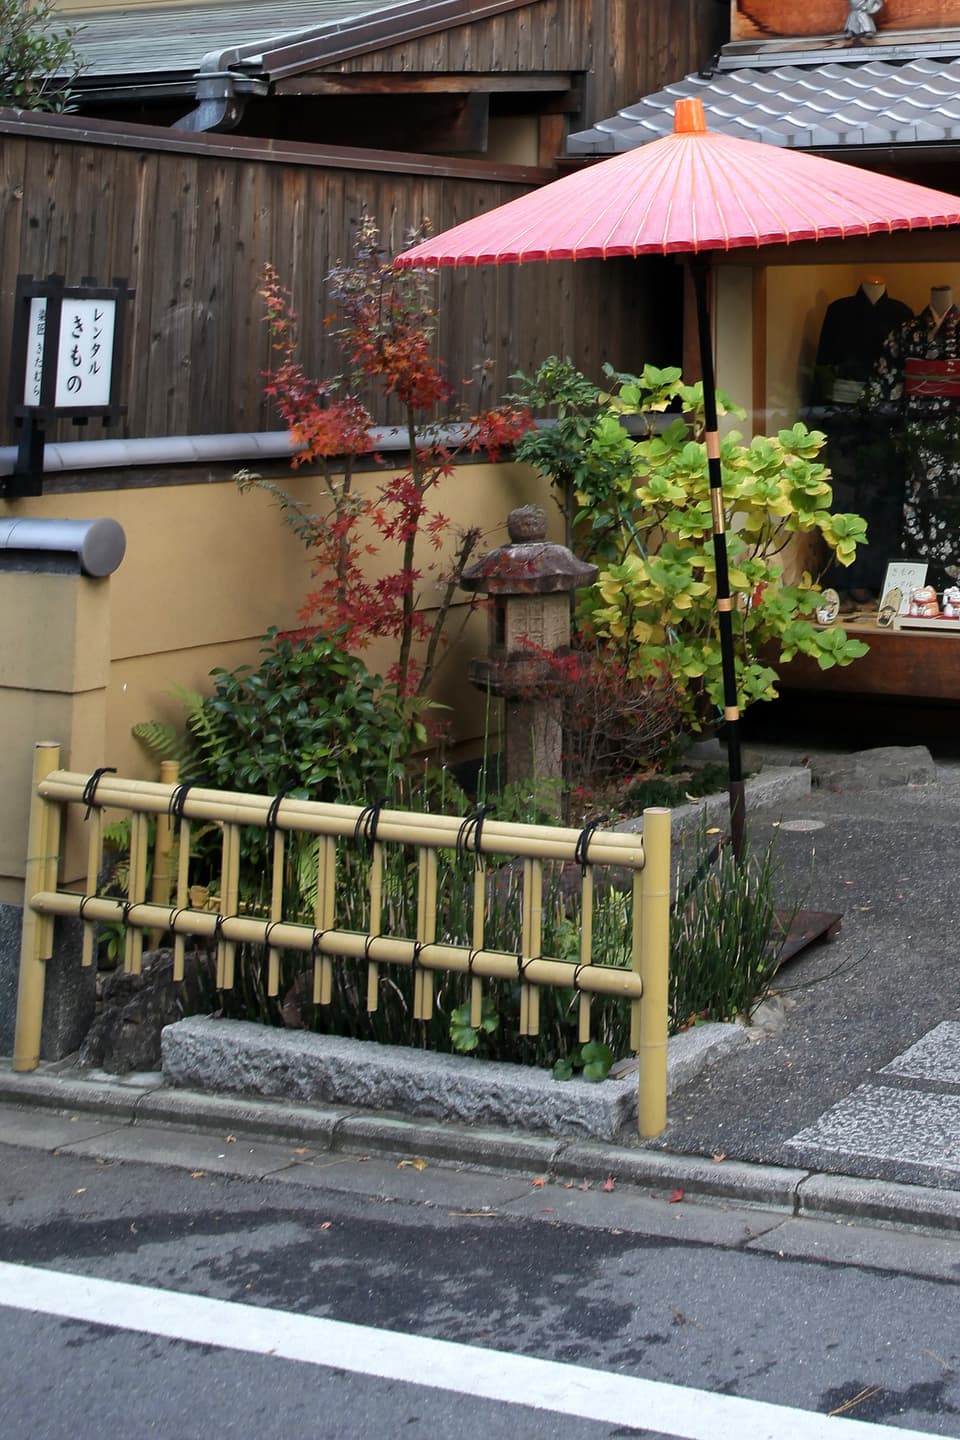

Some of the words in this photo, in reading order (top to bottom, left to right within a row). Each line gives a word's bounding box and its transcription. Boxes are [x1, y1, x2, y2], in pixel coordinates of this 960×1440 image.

[67, 315, 84, 394] きもの
[88, 308, 104, 375] レンタル
